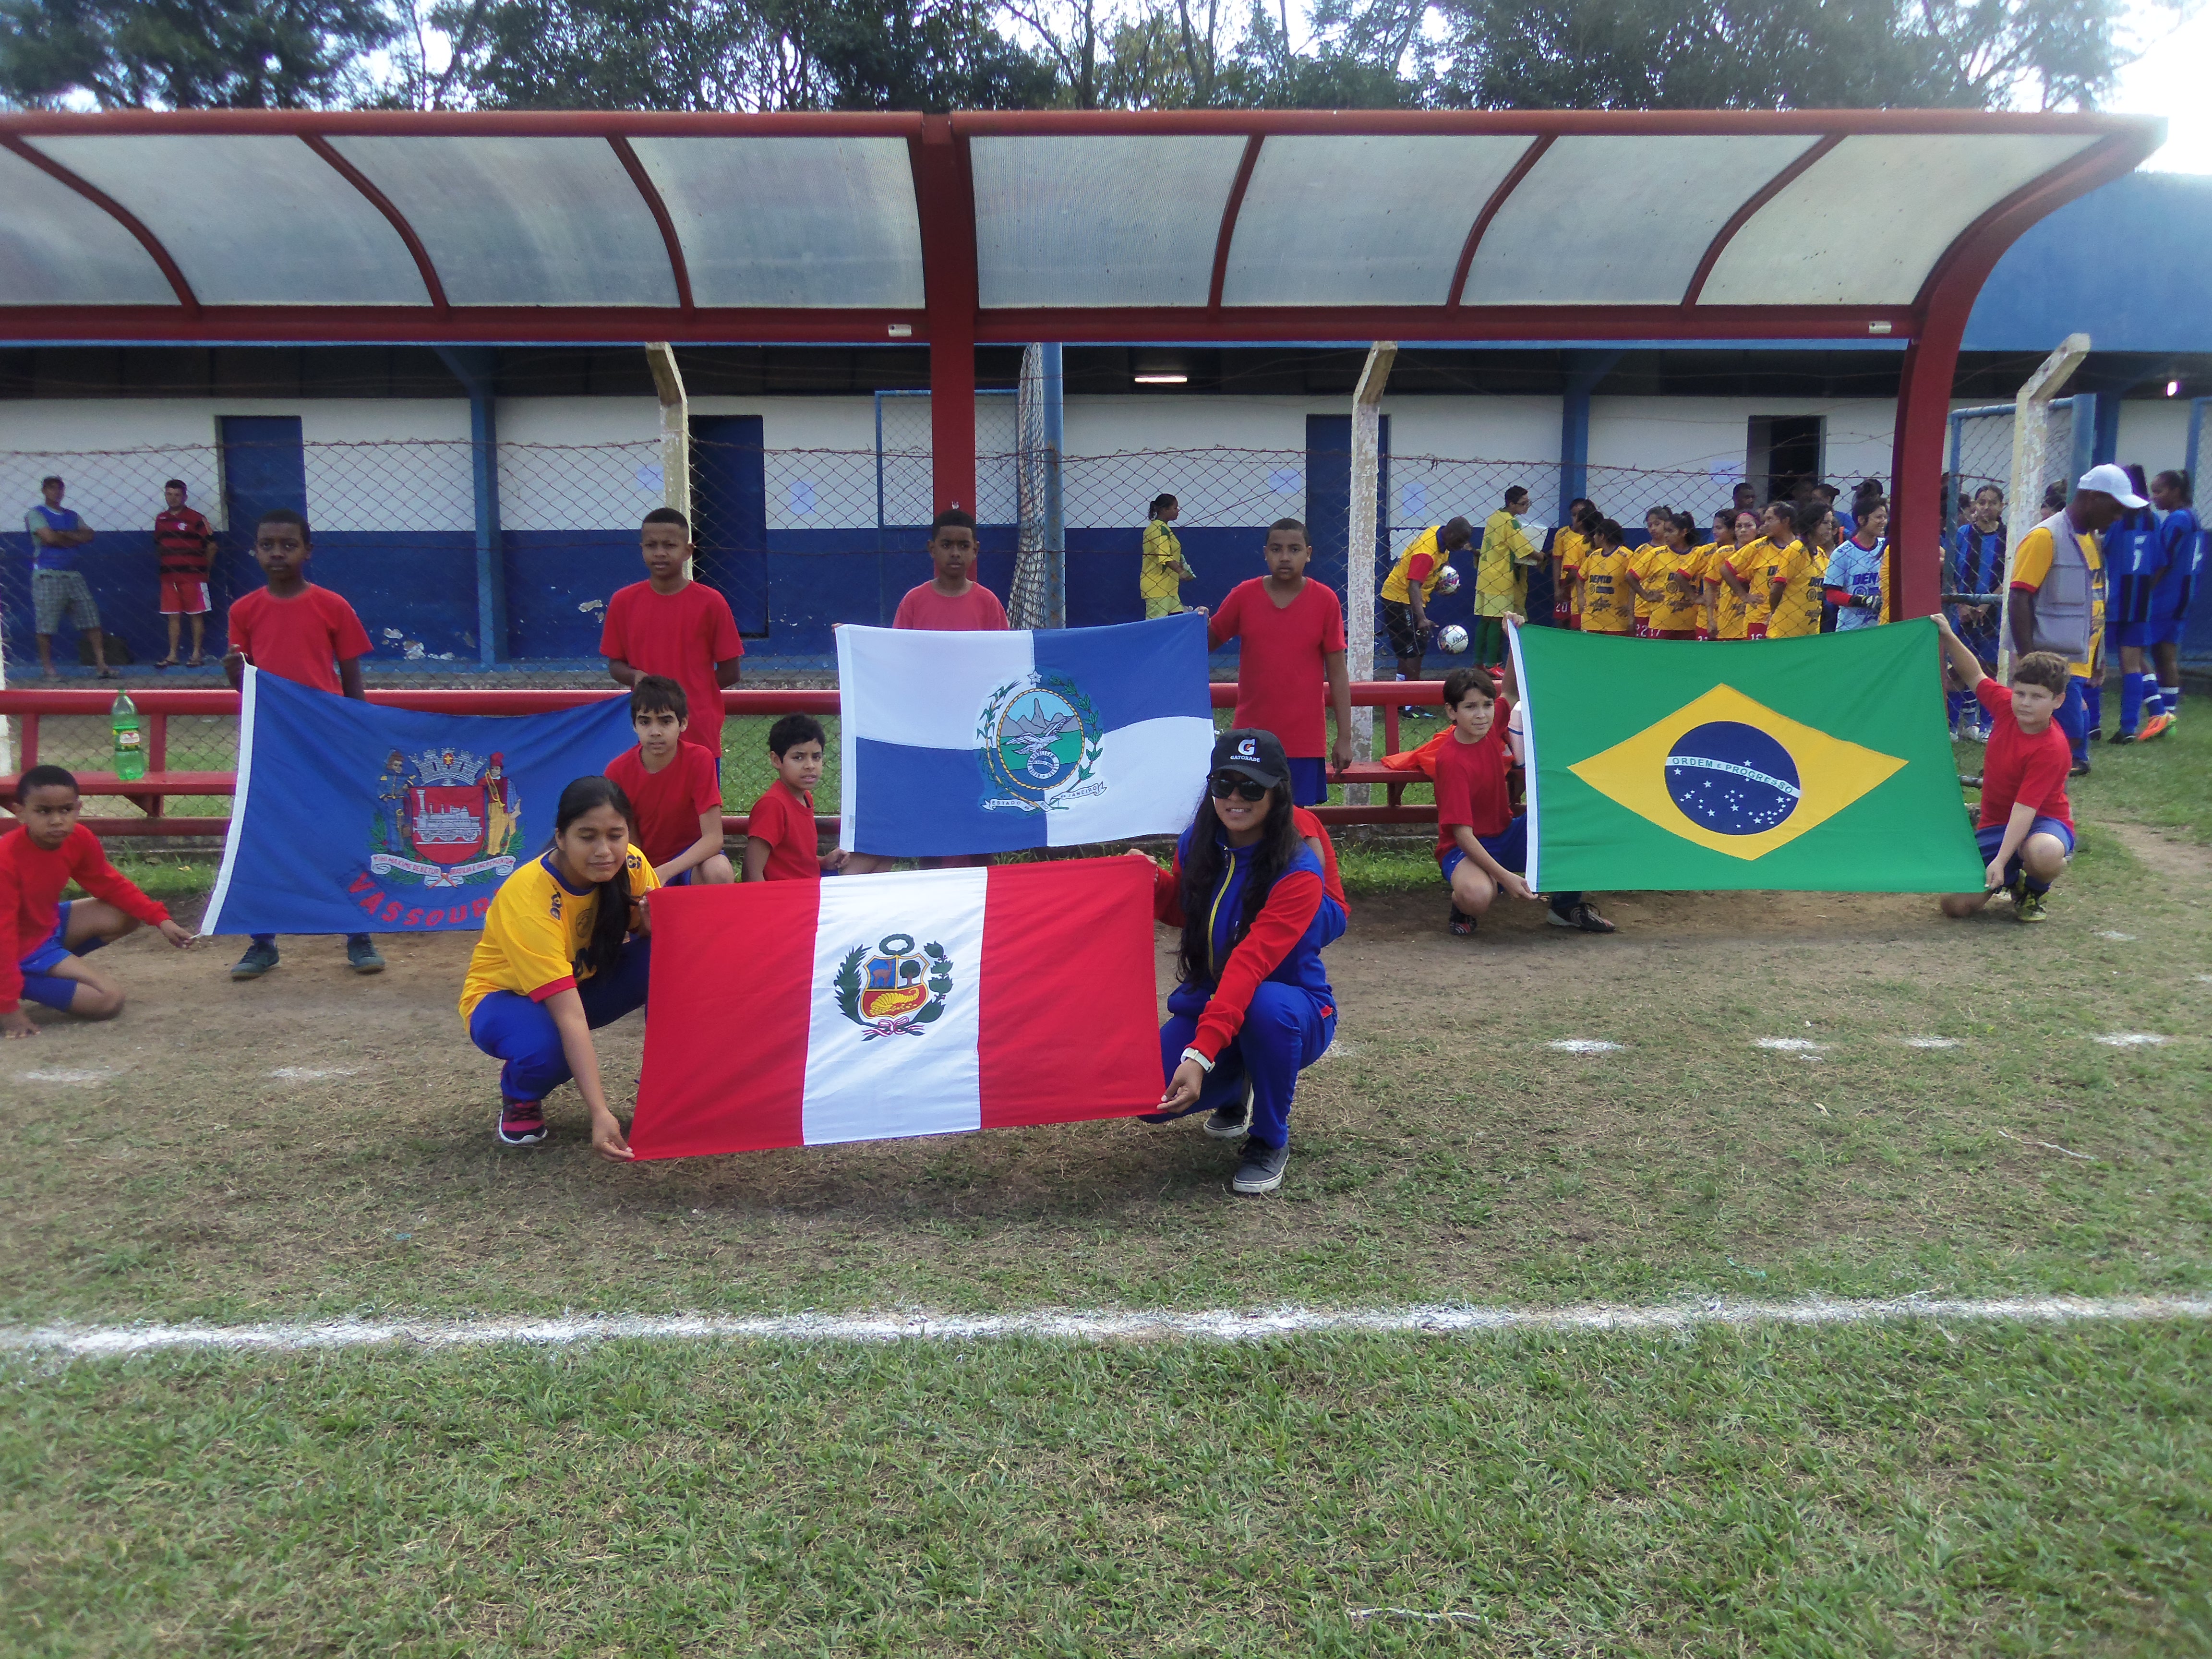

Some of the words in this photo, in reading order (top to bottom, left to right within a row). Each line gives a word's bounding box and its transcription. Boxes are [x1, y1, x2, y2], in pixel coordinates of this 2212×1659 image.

[1672, 757, 1713, 768] ORDEM
[1725, 765, 1793, 793] PROGRESSO
[1068, 786, 1097, 797] JANEIRO
[412, 865, 440, 875] DEBETUR
[349, 871, 501, 926] VASSOUR
